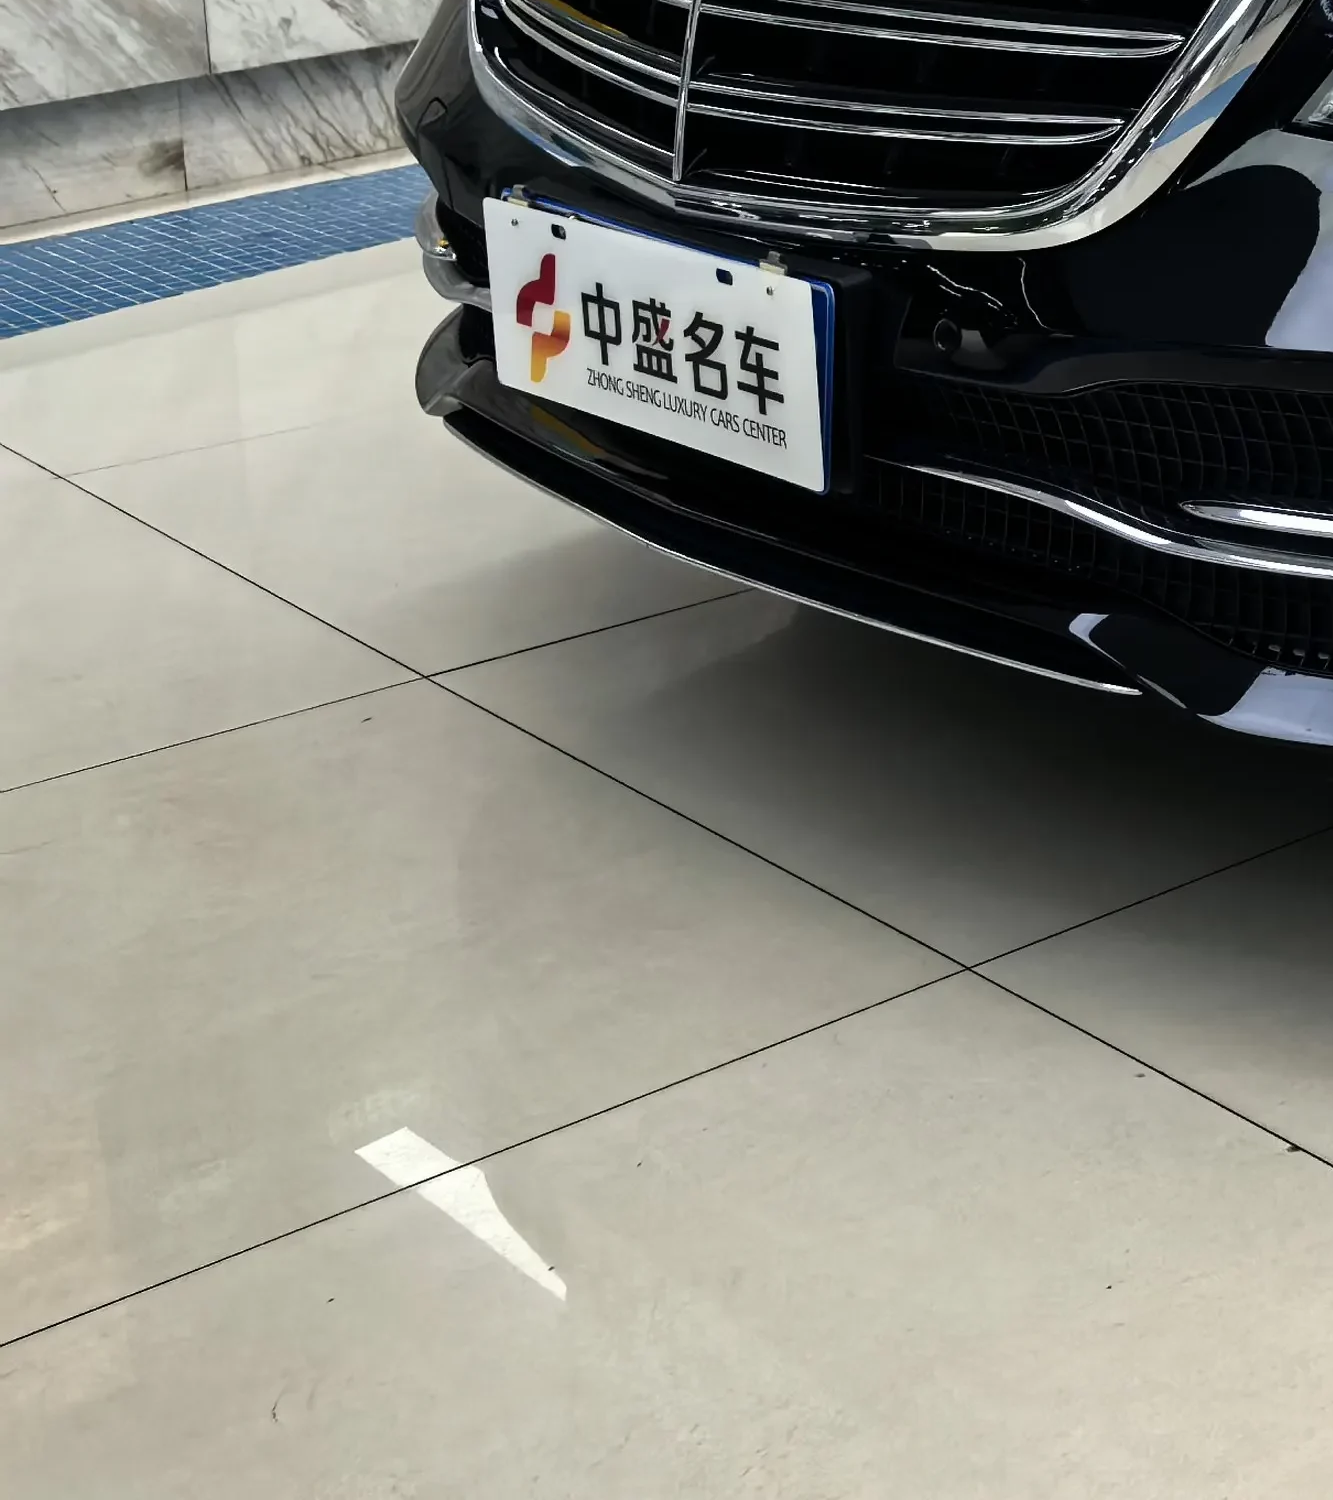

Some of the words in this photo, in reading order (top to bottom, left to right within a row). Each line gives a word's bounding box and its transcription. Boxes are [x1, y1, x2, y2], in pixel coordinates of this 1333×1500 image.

[580, 282, 785, 416] 中盛名车
[586, 367, 624, 396] ZHONG
[626, 380, 662, 409] SHENG
[663, 392, 708, 423] LUXURY
[709, 407, 740, 433] CARS
[742, 418, 787, 449] CENTER
